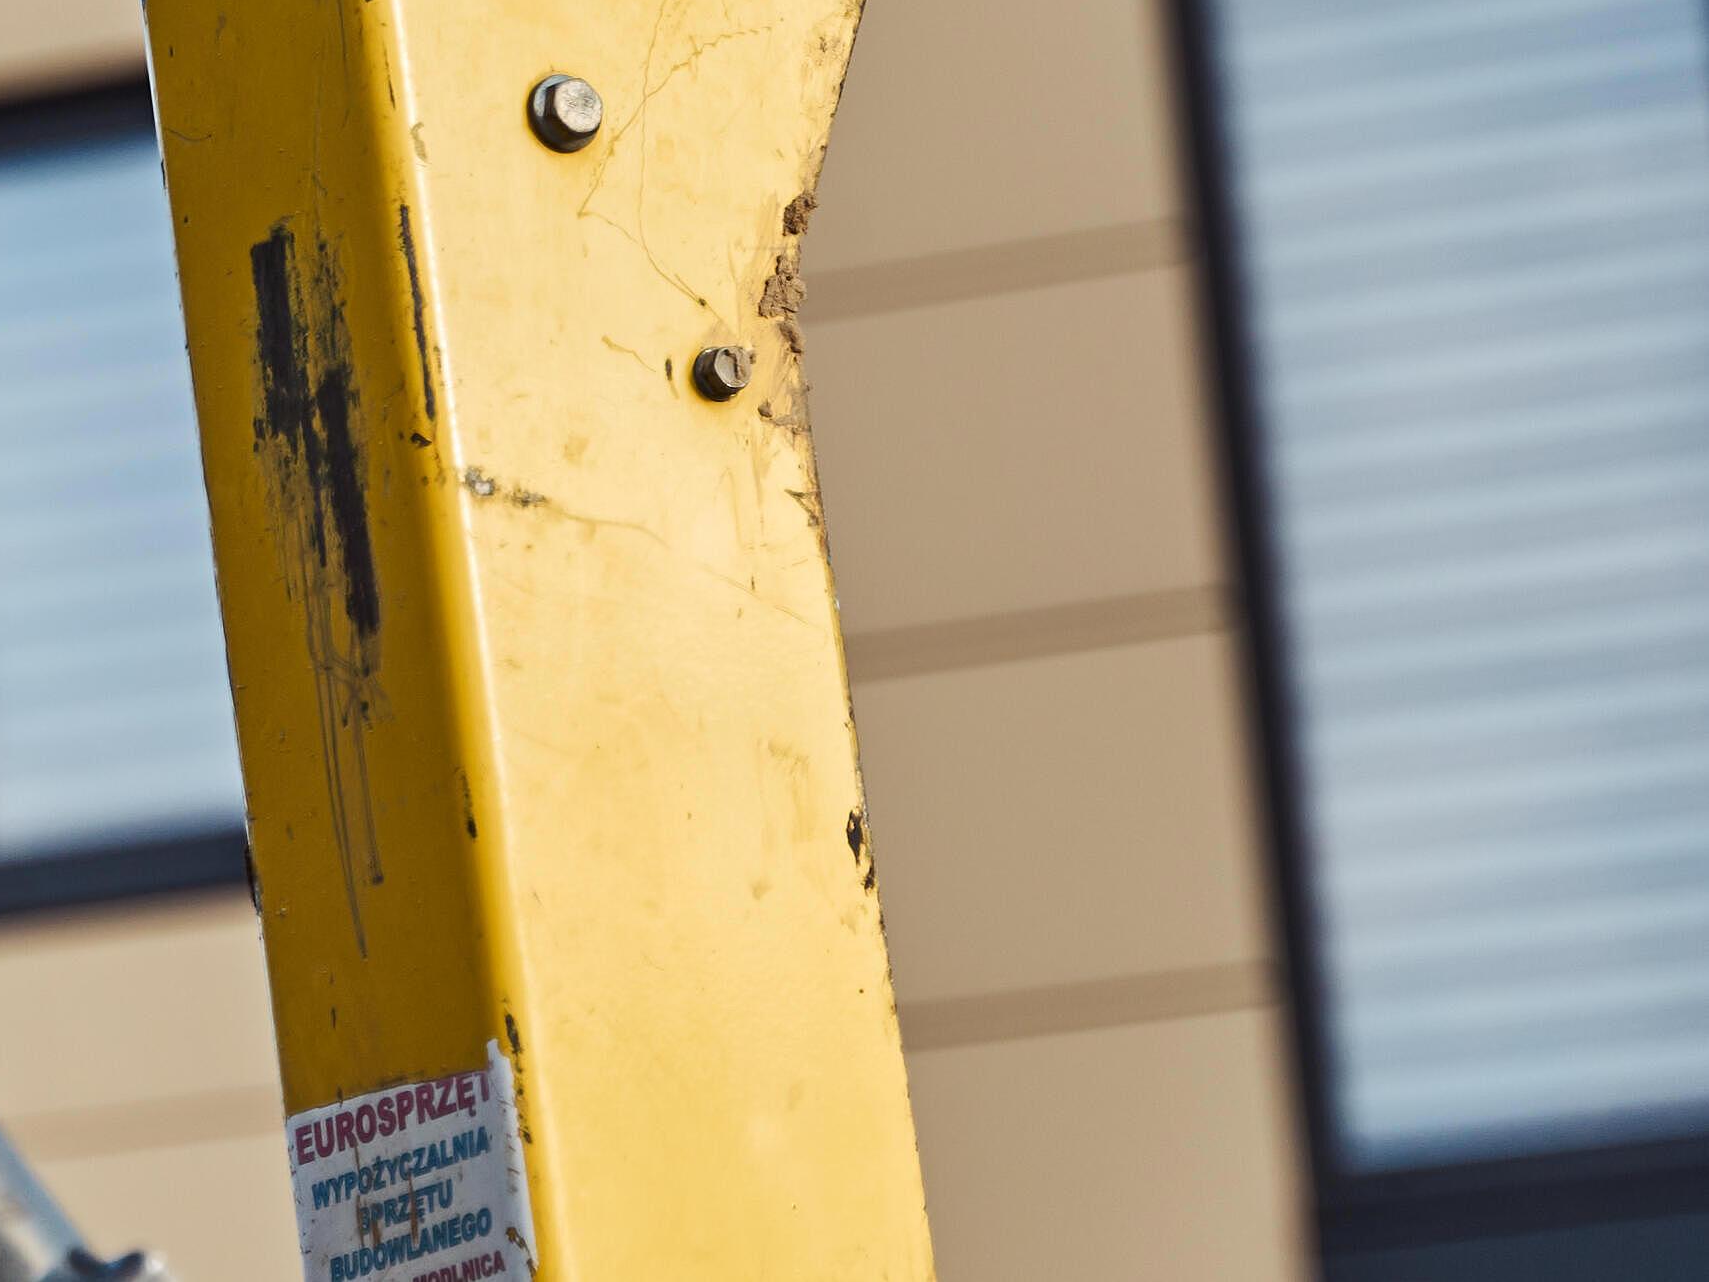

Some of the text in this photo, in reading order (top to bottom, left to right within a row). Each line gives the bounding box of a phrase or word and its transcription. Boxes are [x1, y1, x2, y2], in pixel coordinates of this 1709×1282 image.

[295, 1072, 490, 1166] EUROSPRZĘT
[311, 1126, 490, 1211] WYPOŻYCZALNIA
[330, 1207, 493, 1282] BUDOWLANEGO
